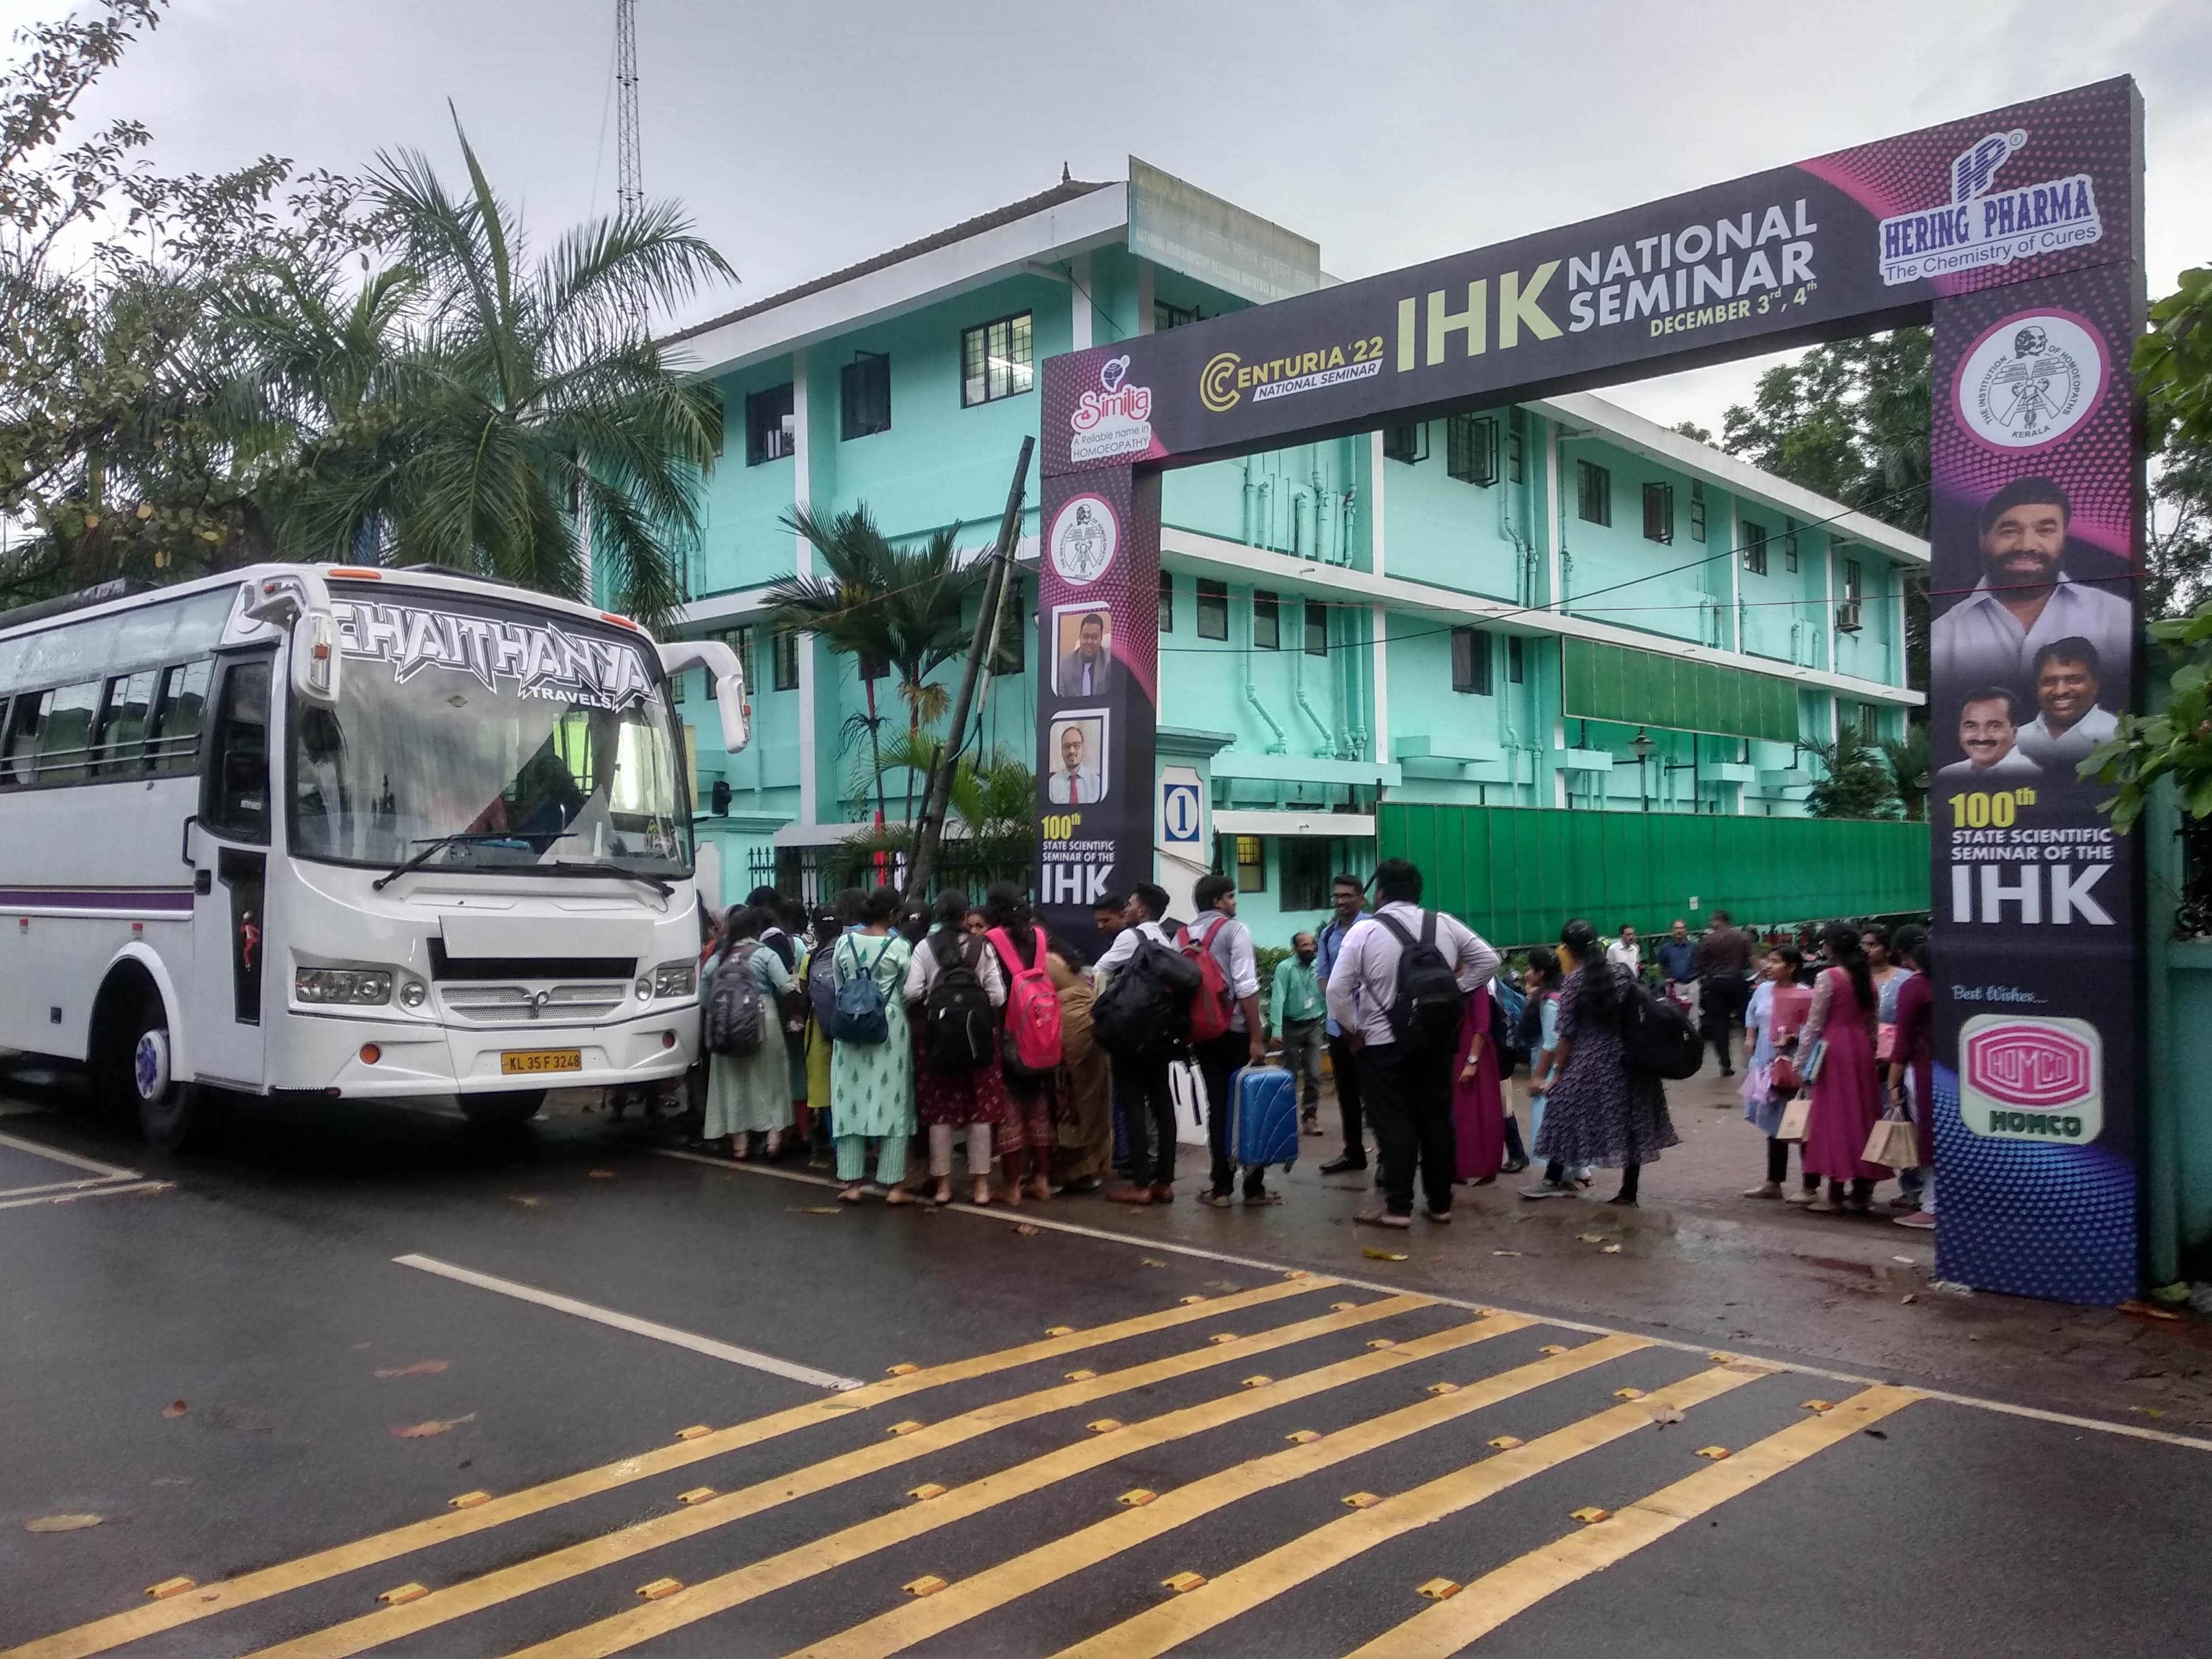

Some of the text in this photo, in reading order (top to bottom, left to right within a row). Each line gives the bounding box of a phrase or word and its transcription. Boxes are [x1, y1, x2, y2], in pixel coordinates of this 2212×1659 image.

[1885, 180, 2092, 259] HERING PHARMA
[1569, 198, 1818, 291] NATIONAL
[1885, 226, 2097, 281] The Chemistry of Cures
[1569, 241, 1817, 333] SEMINAR
[1397, 259, 1565, 373] IHK
[1650, 299, 1751, 338] DECEMBER
[1793, 281, 1817, 306] 4th
[2048, 345, 2062, 354] OF
[1200, 352, 1345, 412] CENTURIA
[1259, 363, 1377, 399] NATIONAL SEMINAR
[1979, 355, 2007, 407] INSTITUTION
[2060, 351, 2081, 415] HOMOEOPATHS
[1074, 388, 1149, 430] Similia
[1980, 409, 1993, 425] THE
[1074, 437, 1149, 459] HOMOEOPATHY
[1082, 431, 1113, 444] Reliable
[1115, 427, 1139, 437] name
[1142, 424, 1149, 433] in
[2012, 426, 2051, 438] KERALA
[528, 686, 612, 709] TRAVELS
[1177, 794, 1188, 832] 1
[1948, 787, 2037, 828] 100th
[1041, 812, 1082, 840] 100th
[1952, 828, 2114, 844] STATE SCIENTIFIC
[1042, 852, 1116, 863] SEMINAR OF THE
[1043, 840, 1115, 851] STATE SCIENTIFIC
[1951, 844, 2115, 861] SEMINAR OF THE
[1041, 864, 1115, 905] IHK
[1952, 864, 2118, 926] IHK
[1952, 984, 1982, 1001] Best
[510, 1055, 581, 1070] KL 35 F 3248
[1989, 1110, 2081, 1138] HOMCO
